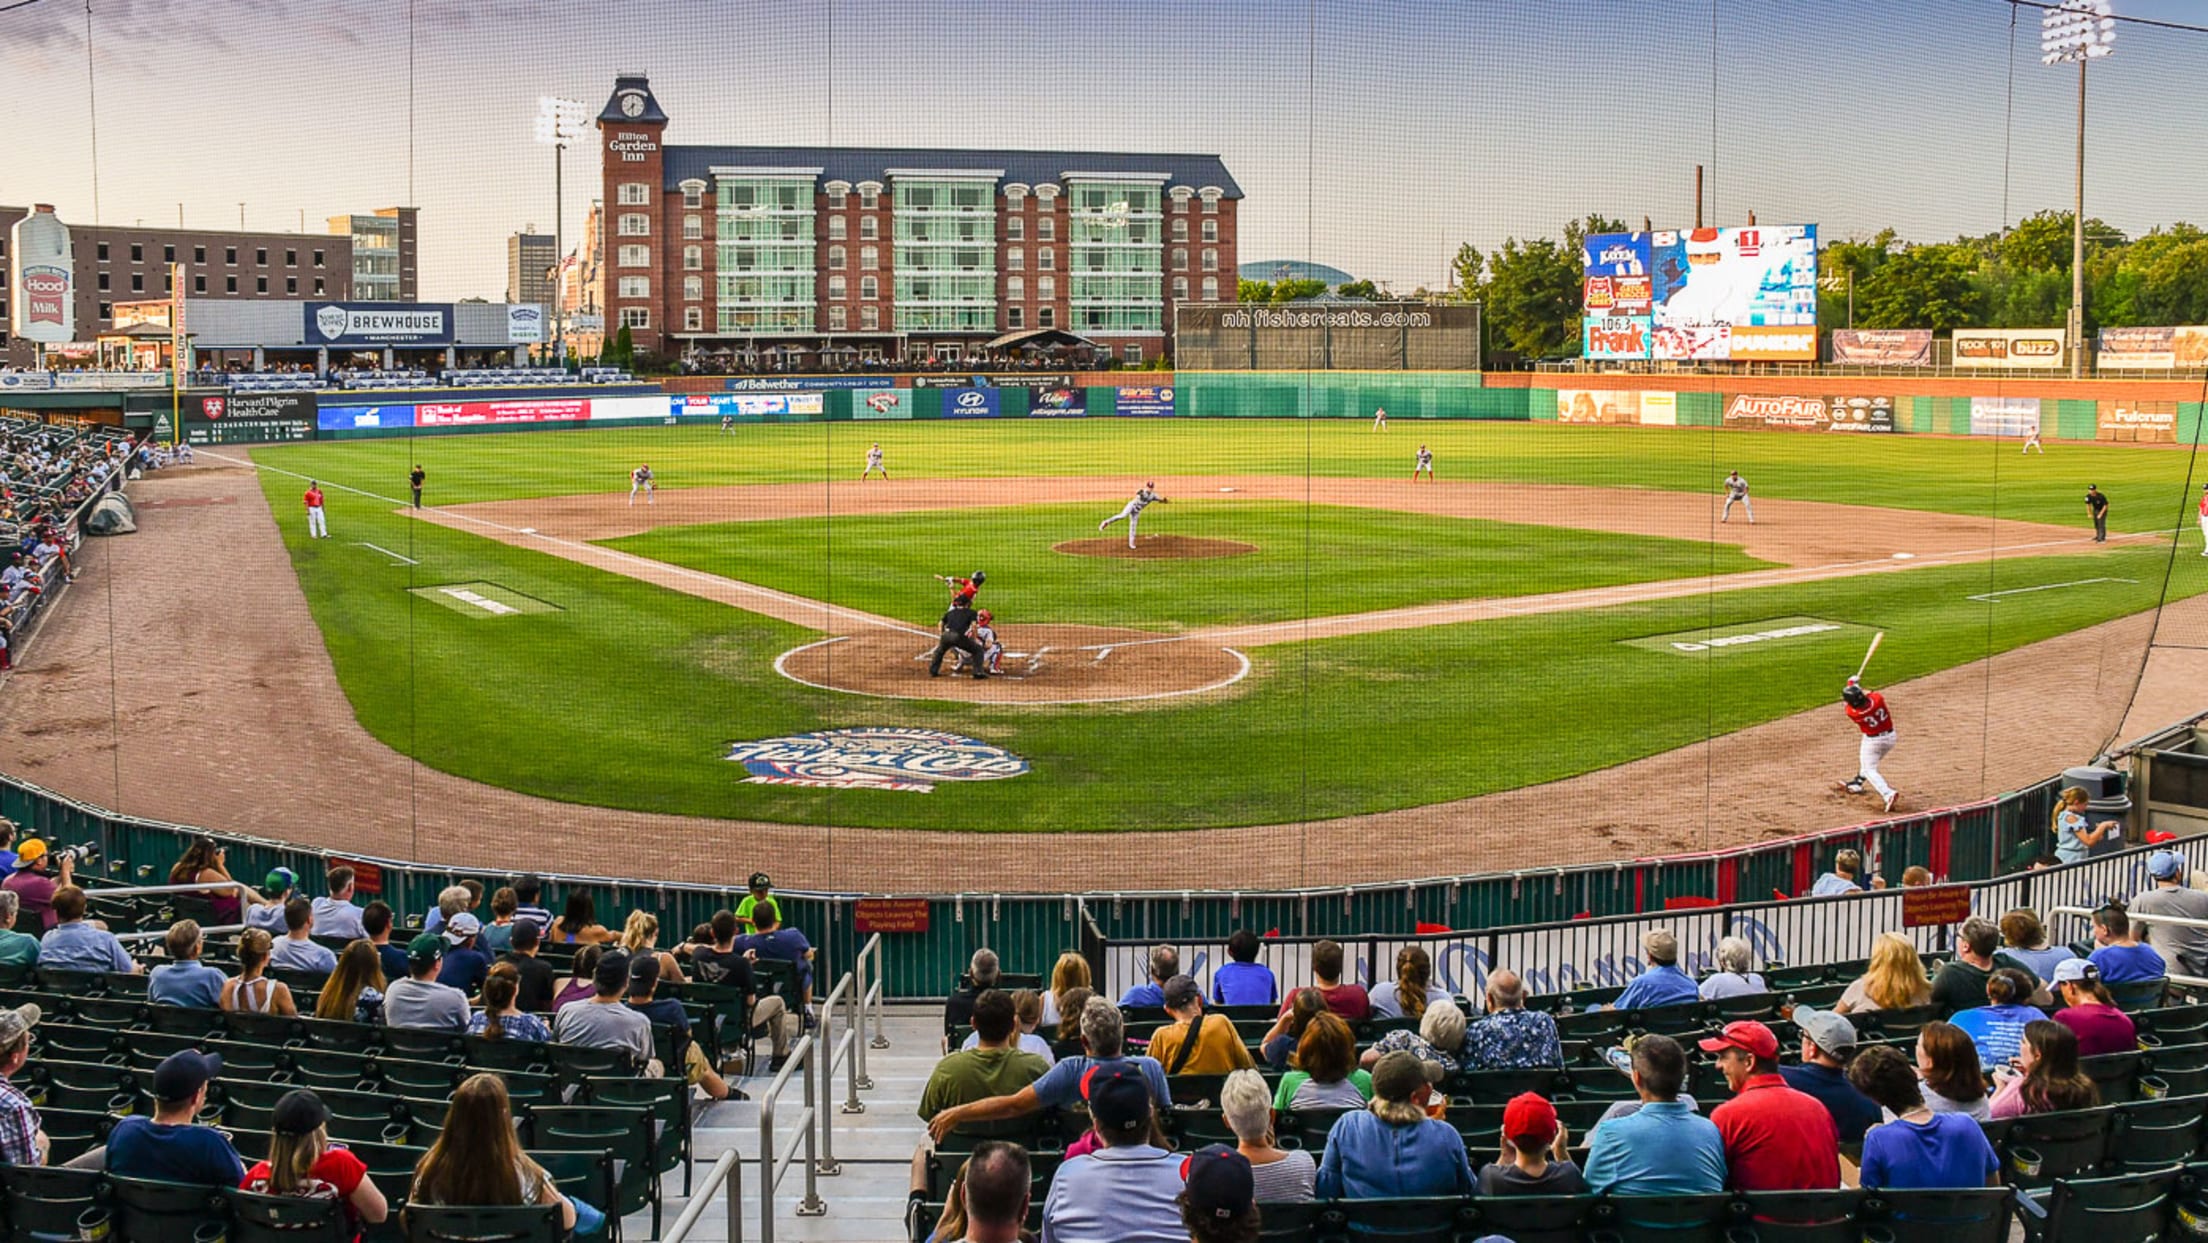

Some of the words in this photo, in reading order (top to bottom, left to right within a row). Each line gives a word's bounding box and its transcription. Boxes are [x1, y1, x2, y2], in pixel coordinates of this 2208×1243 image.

[618, 132, 648, 140] Hilton
[609, 140, 656, 151] Garden
[622, 151, 644, 160] Inn
[27, 279, 64, 291] Hood
[32, 302, 60, 314] Milk
[353, 316, 440, 329] BREWHOUSE
[1602, 318, 1631, 331] 106.3
[1589, 323, 1645, 352] Frank
[177, 334, 186, 359] AUTO
[1959, 340, 1986, 350] ROCK
[1990, 340, 2006, 350] 101
[2015, 341, 2055, 354] buzz
[748, 379, 800, 389] Bellwether
[227, 397, 266, 407] Harvard
[267, 396, 298, 408] Pilgrim
[1732, 398, 1822, 417] AUTOFAIR
[227, 407, 258, 418] Health
[258, 407, 280, 417] Care
[953, 407, 989, 415] HYUNDAI
[2115, 408, 2174, 422] Fulcrum
[1864, 708, 1889, 728] 32
[856, 911, 883, 919] Objects
[884, 911, 914, 920] Leaving
[914, 910, 928, 919] The
[869, 920, 896, 929] Playing
[896, 920, 915, 928] Field
